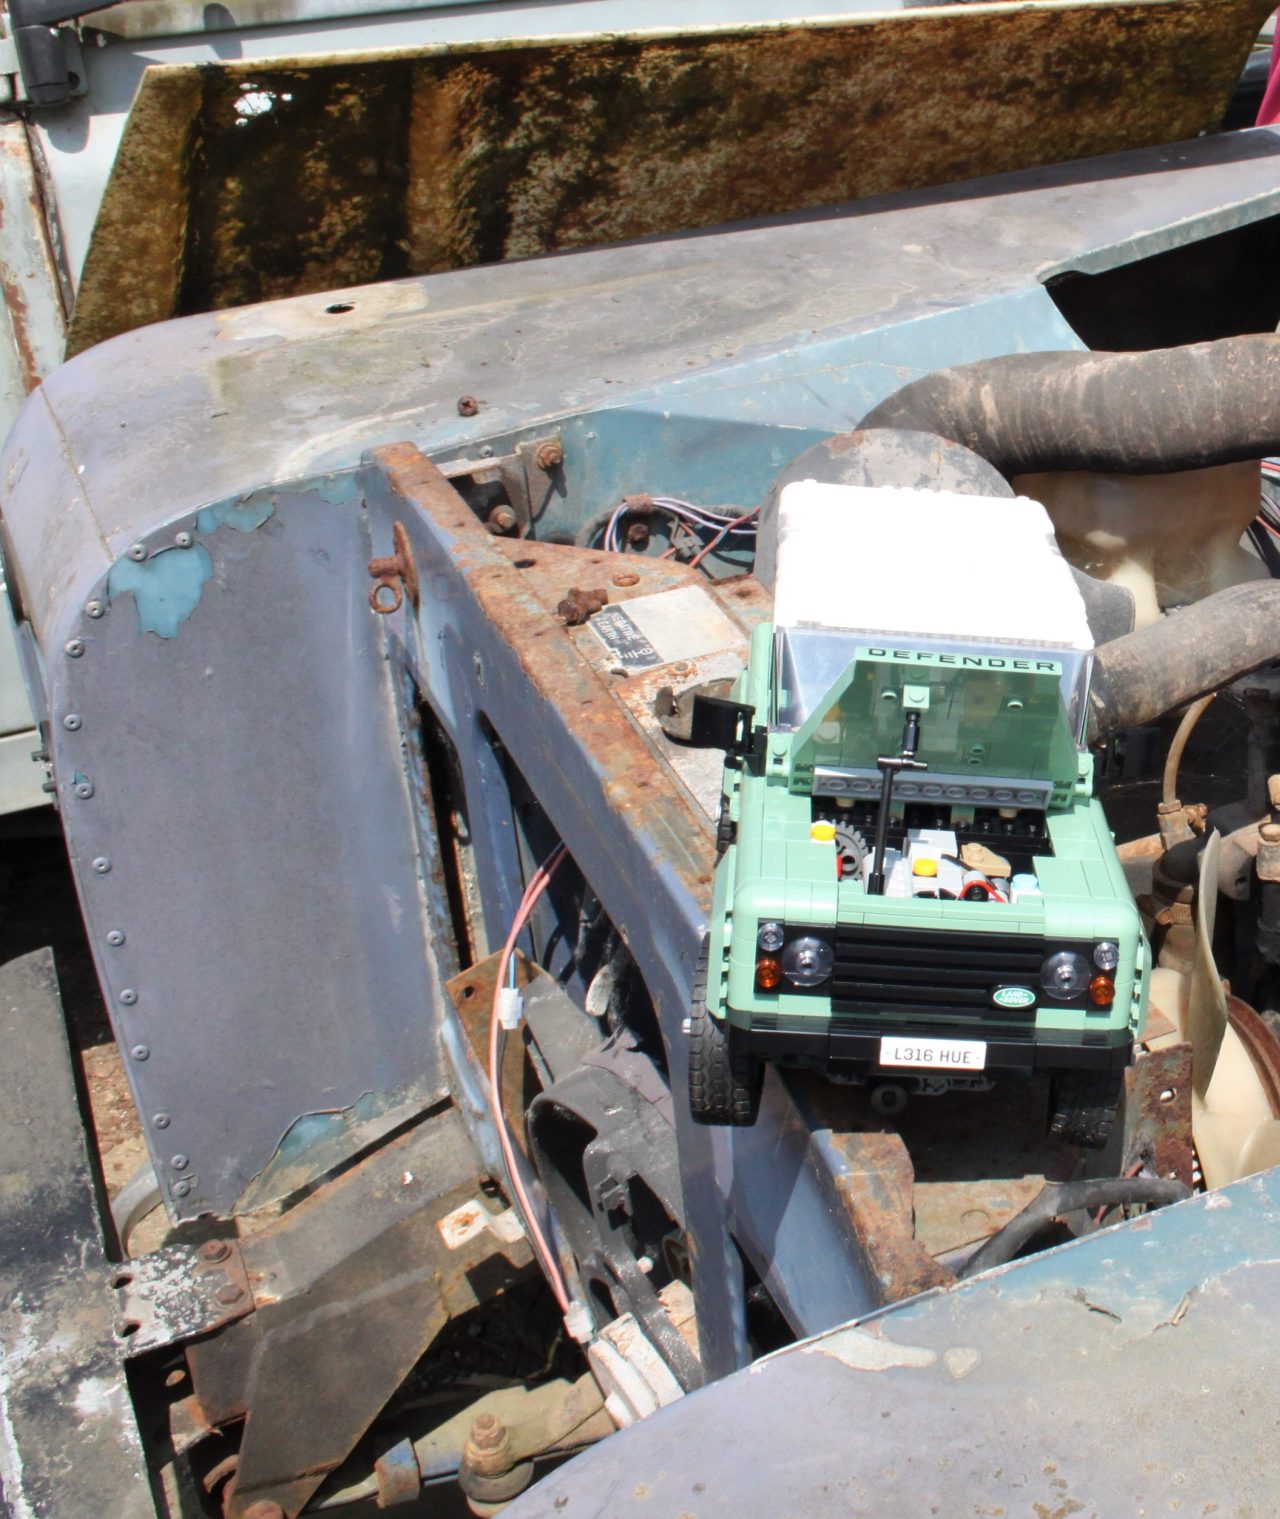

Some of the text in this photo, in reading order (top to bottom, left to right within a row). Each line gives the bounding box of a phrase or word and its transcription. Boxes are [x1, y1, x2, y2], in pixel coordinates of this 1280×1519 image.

[868, 648, 1055, 672] DEFENDER
[894, 1047, 972, 1064] L316 HUE
